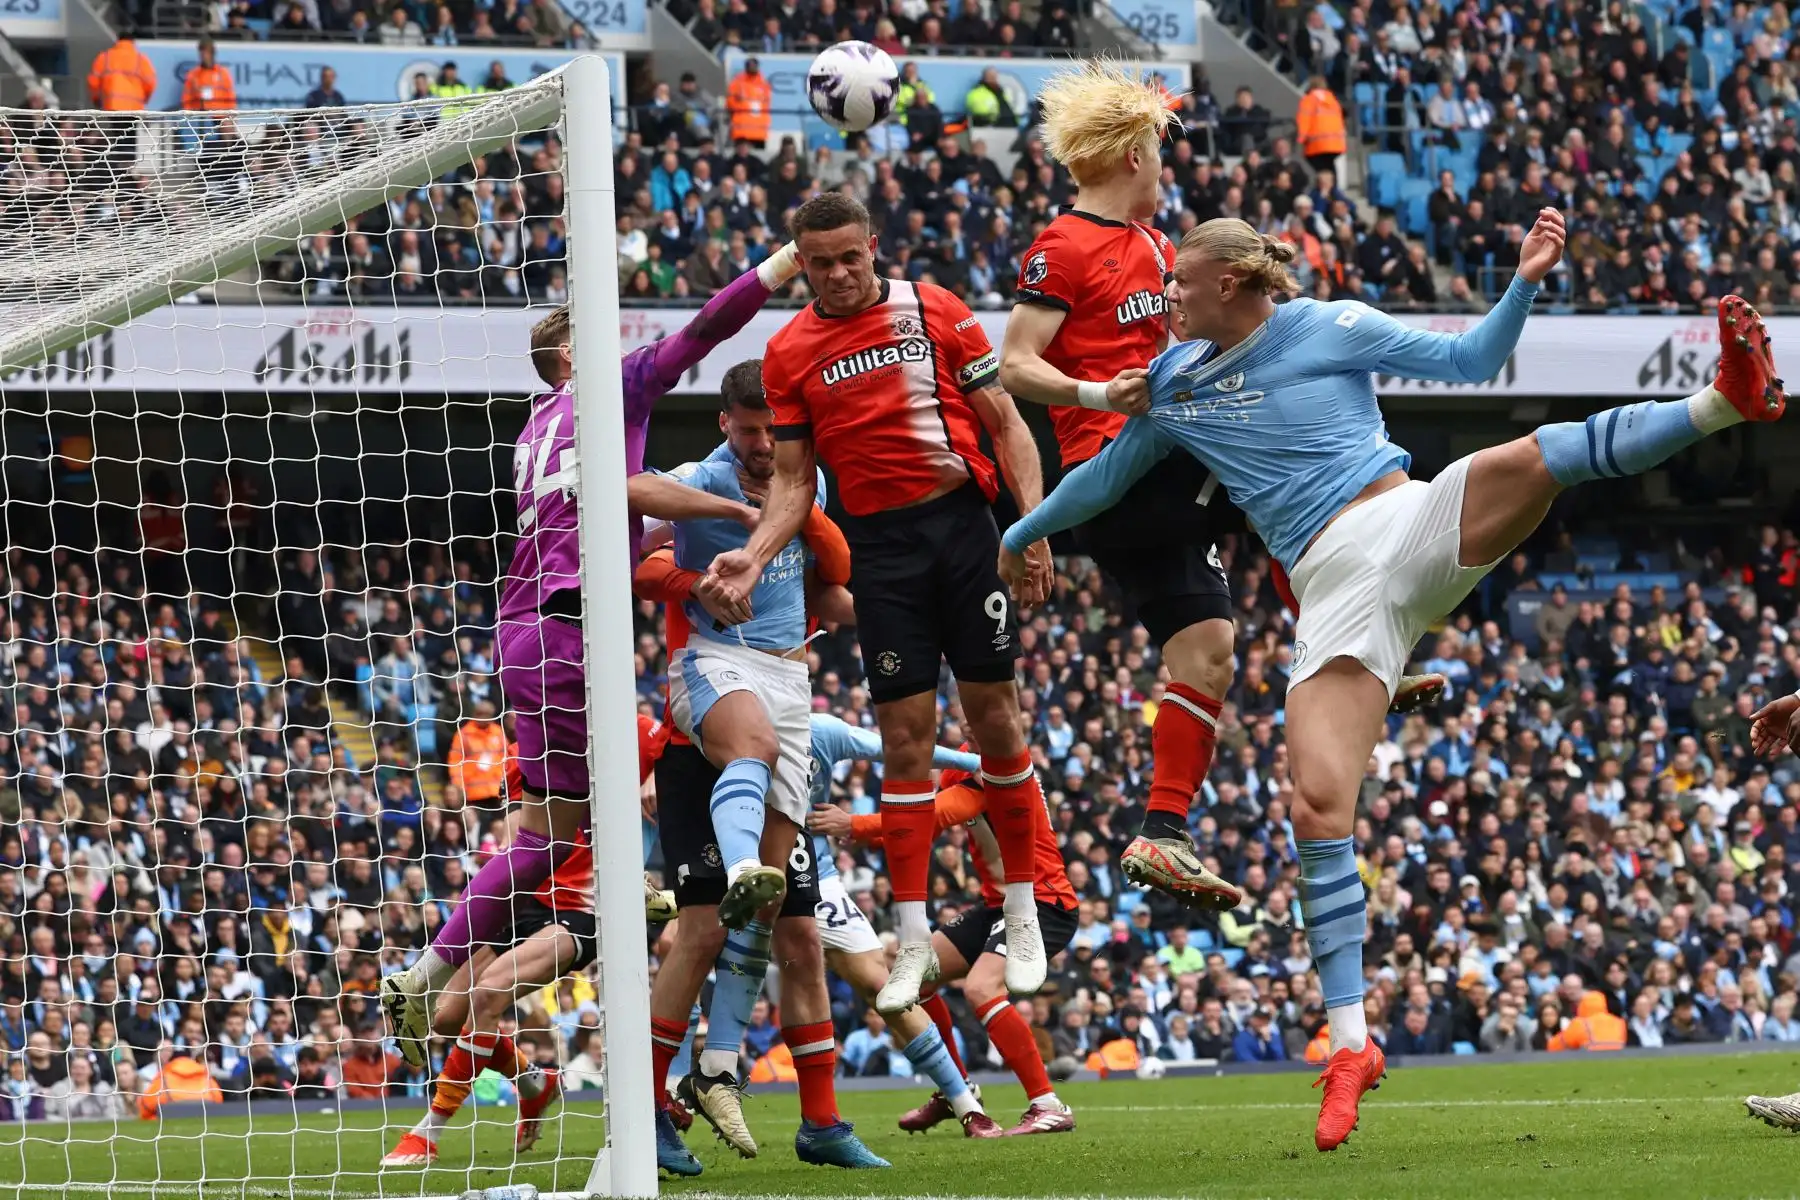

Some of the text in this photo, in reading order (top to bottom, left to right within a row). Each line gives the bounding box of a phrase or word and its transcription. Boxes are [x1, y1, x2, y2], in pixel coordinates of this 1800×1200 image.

[573, 0, 627, 27] 224
[1128, 12, 1181, 39] 225
[1116, 291, 1165, 325] utilita
[253, 327, 411, 385] Asahi
[821, 345, 901, 386] utilita
[984, 590, 1008, 635] 9
[788, 832, 811, 872] 8
[816, 897, 866, 929] 24
